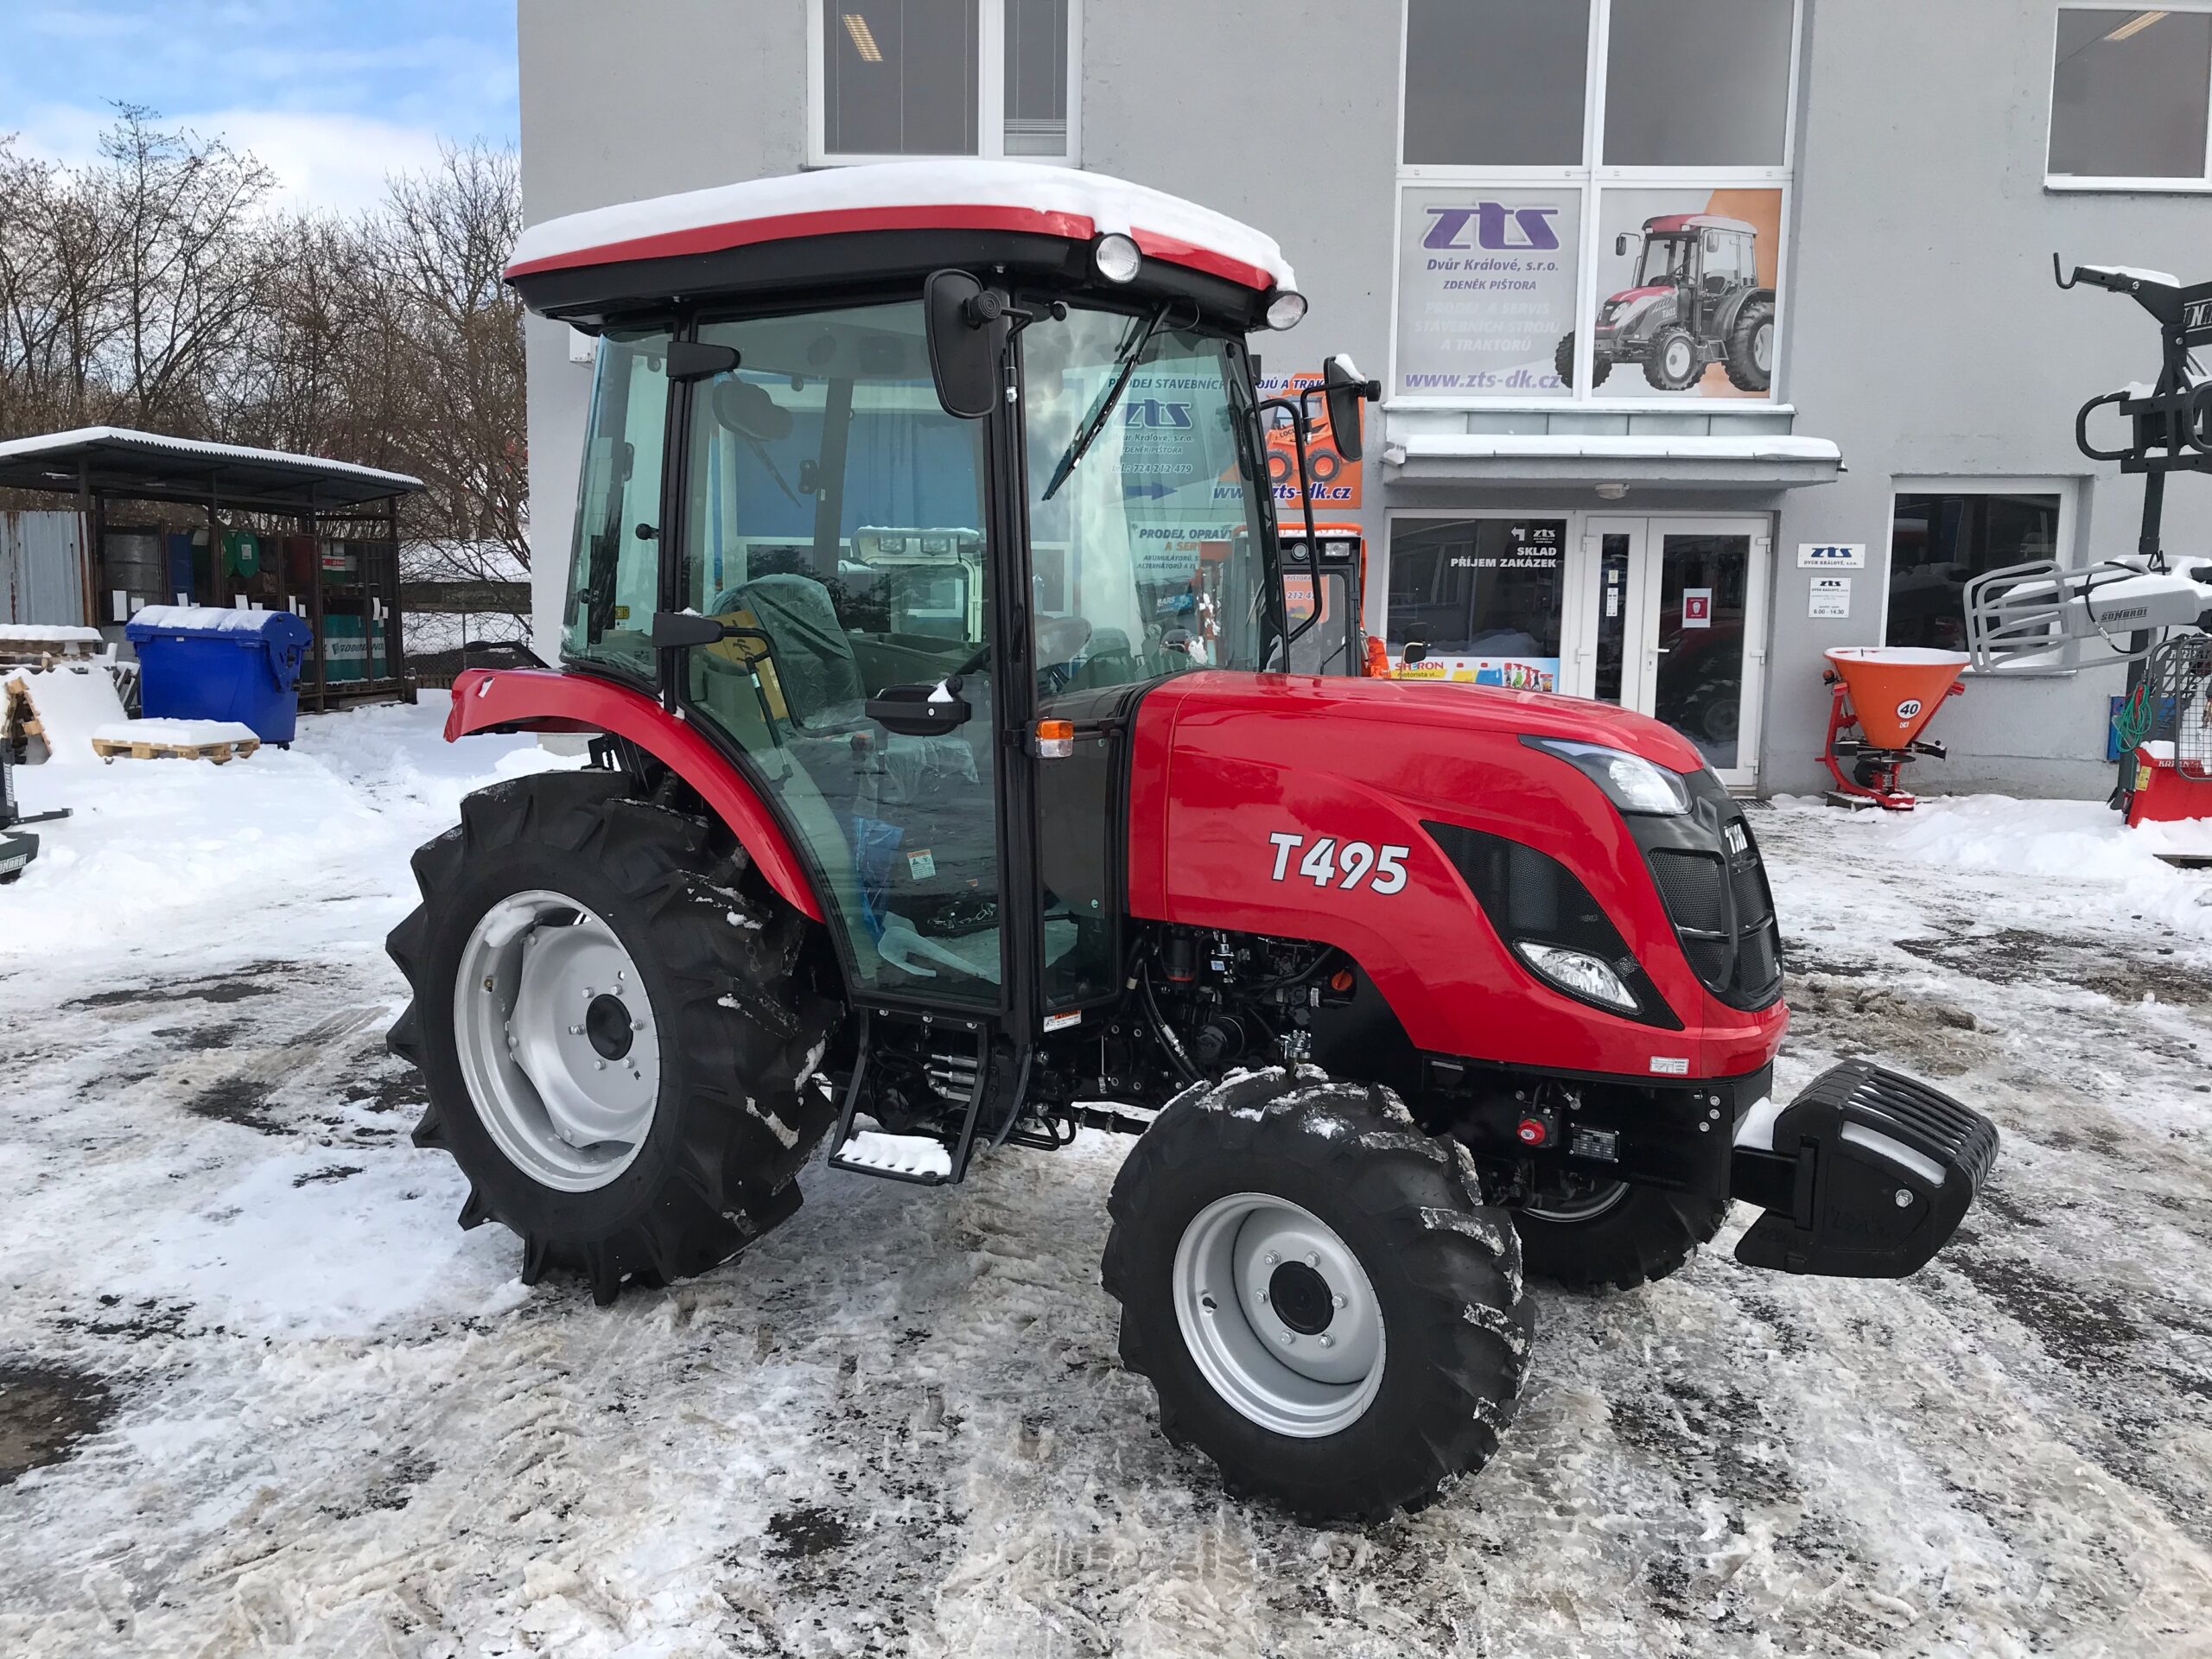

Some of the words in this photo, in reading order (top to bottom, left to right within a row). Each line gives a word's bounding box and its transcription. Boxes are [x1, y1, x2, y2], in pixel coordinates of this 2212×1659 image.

[1424, 202, 1560, 250] zts
[1427, 257, 1460, 270] Dvůr
[1464, 257, 1521, 272] Králové,
[1526, 261, 1559, 271] s.r.o.
[1443, 278, 1486, 290] ZDENĚK
[1490, 278, 1536, 290] PIŠTORA
[1502, 302, 1550, 315] SERVIS
[1414, 318, 1503, 333] STAVEBNÍCH
[1508, 318, 1560, 334] STROJŮ
[1440, 338, 1452, 351] A
[1456, 335, 1533, 352] TRAKTORŮ
[1108, 378, 1153, 388] PDEJ
[1281, 379, 1289, 389] A
[1294, 379, 1325, 389] TRAK
[1405, 370, 1561, 389] www.zts-dk.cz
[1151, 445, 1183, 454] PIŠTORA
[1133, 464, 1151, 473] 724
[1153, 464, 1171, 473] 212
[1173, 464, 1192, 474] 479
[1139, 529, 1185, 539] PRODEJ,
[1516, 547, 1557, 556] SKLAD
[1811, 547, 1853, 557] zts
[1451, 556, 1497, 568] PŘÍJEM
[1499, 556, 1556, 568] ZAKÁZEK
[1395, 662, 1444, 671] SHERON
[1900, 703, 1918, 715] 40
[1269, 831, 1411, 895] T495
